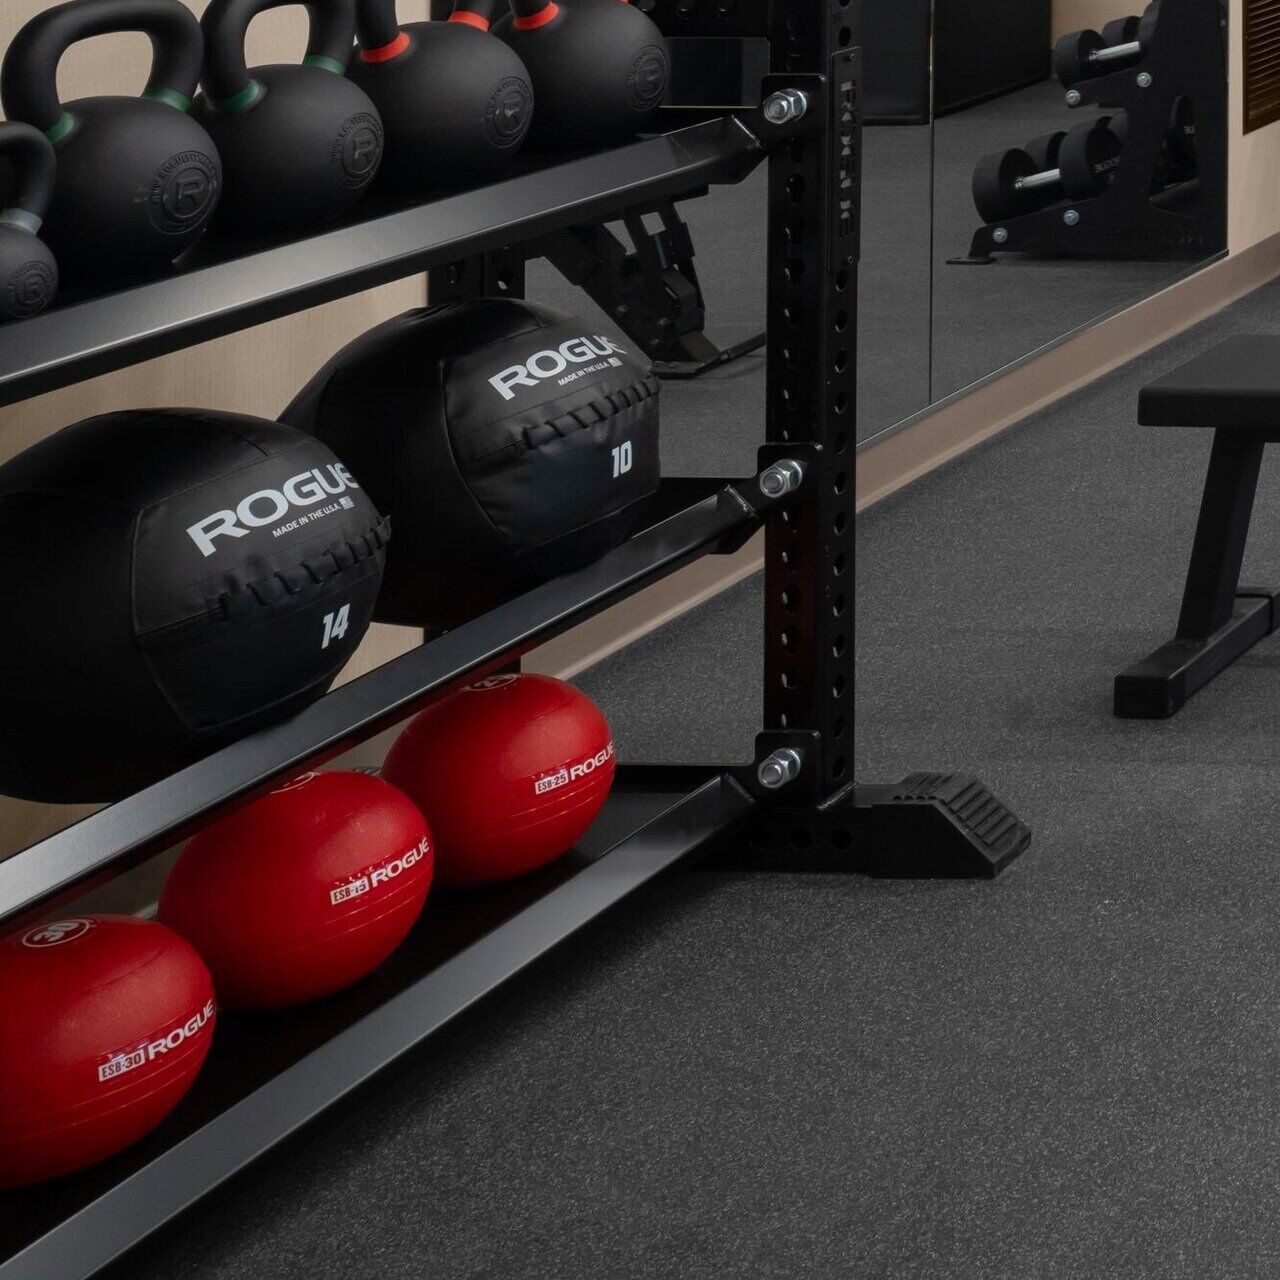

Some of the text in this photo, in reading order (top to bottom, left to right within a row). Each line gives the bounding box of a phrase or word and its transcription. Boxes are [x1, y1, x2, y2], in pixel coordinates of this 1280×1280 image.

[557, 372, 579, 387] MADE
[577, 369, 587, 378] IN
[584, 365, 598, 375] THE
[612, 440, 632, 478] 10
[272, 520, 300, 538] MADE
[298, 516, 309, 526] IN
[308, 509, 325, 521] THE
[321, 603, 351, 650] 14
[537, 774, 568, 793] ESB-25
[371, 836, 430, 888] ROGUE
[102, 999, 213, 1078] ESB-30 ROGUE
